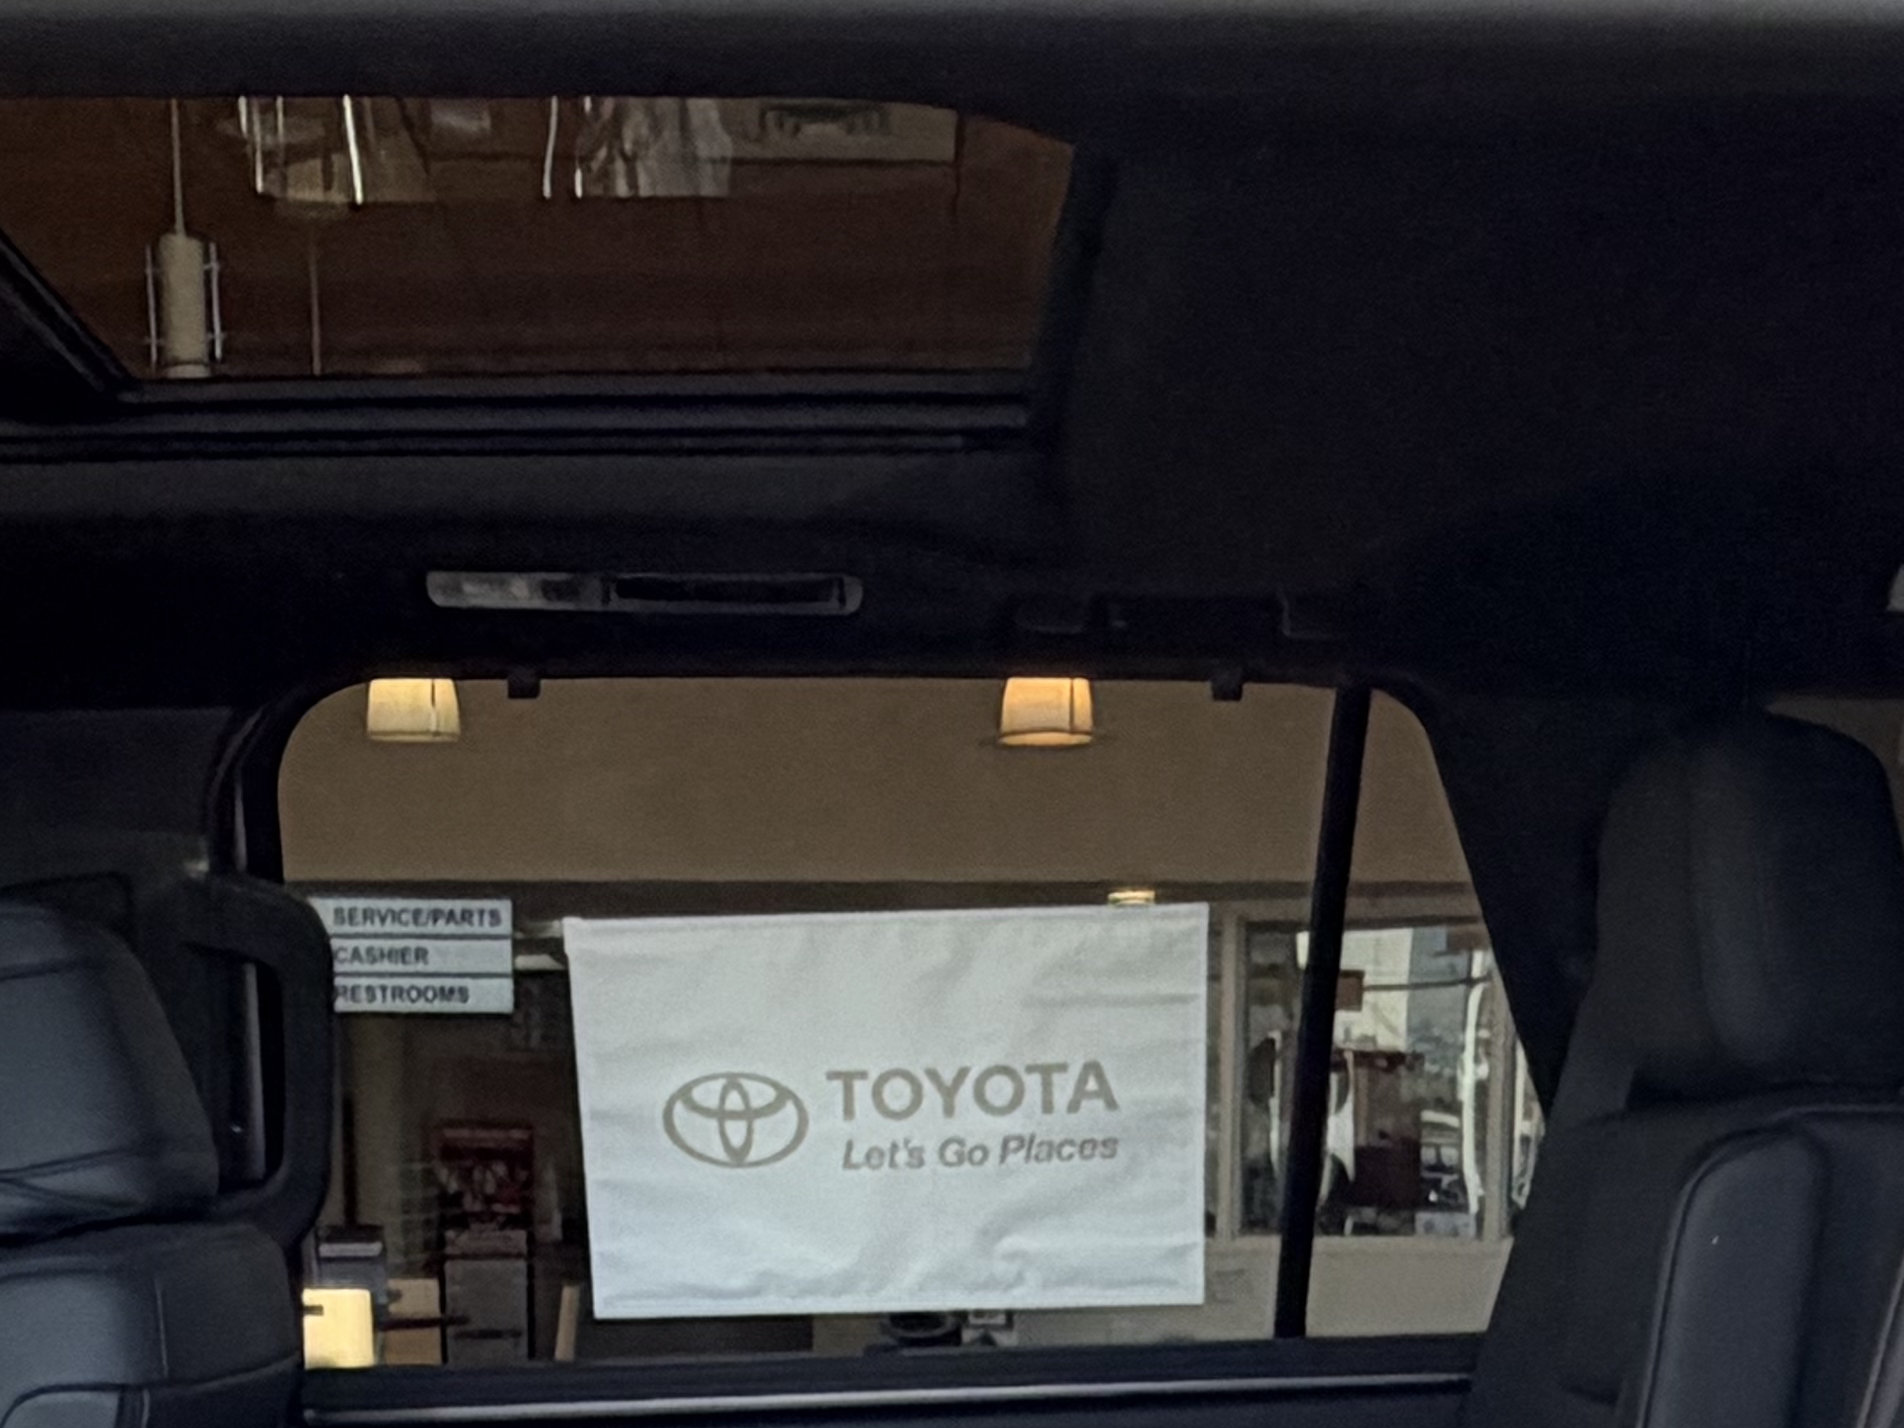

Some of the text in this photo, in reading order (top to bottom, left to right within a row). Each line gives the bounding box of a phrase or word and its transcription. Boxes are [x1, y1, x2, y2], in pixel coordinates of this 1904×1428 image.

[333, 906, 502, 928] SERVICE/PARTS
[334, 945, 429, 967] CASHIER
[335, 984, 470, 1005] RESTROOMS
[825, 1060, 1119, 1121] TOYOTA
[842, 1132, 1119, 1170] Let's Go Places
